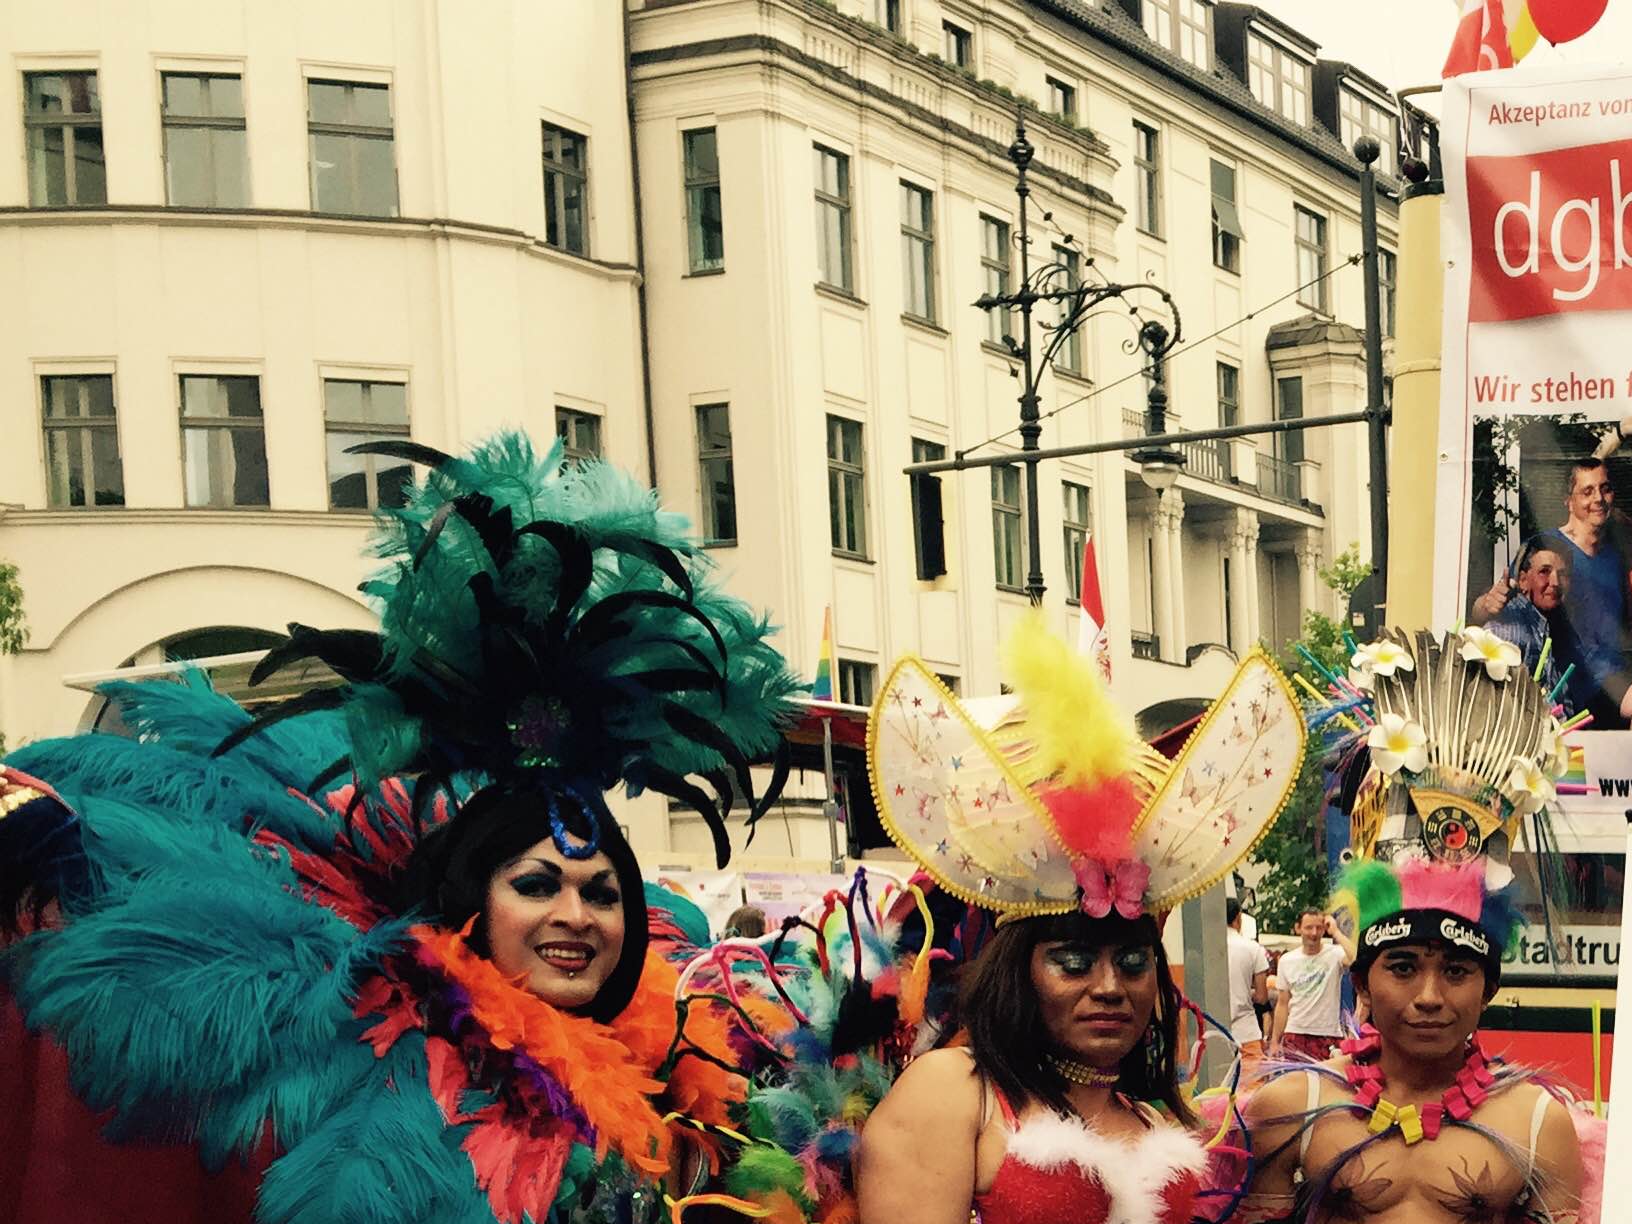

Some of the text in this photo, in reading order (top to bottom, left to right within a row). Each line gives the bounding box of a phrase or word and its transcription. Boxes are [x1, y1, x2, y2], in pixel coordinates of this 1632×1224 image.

[1488, 100, 1592, 127] Akzeptanz
[1474, 374, 1521, 403] Wir
[1530, 371, 1616, 404] stehen
[1365, 917, 1412, 947] Carlsberg
[1440, 917, 1490, 956] Carlsberg
